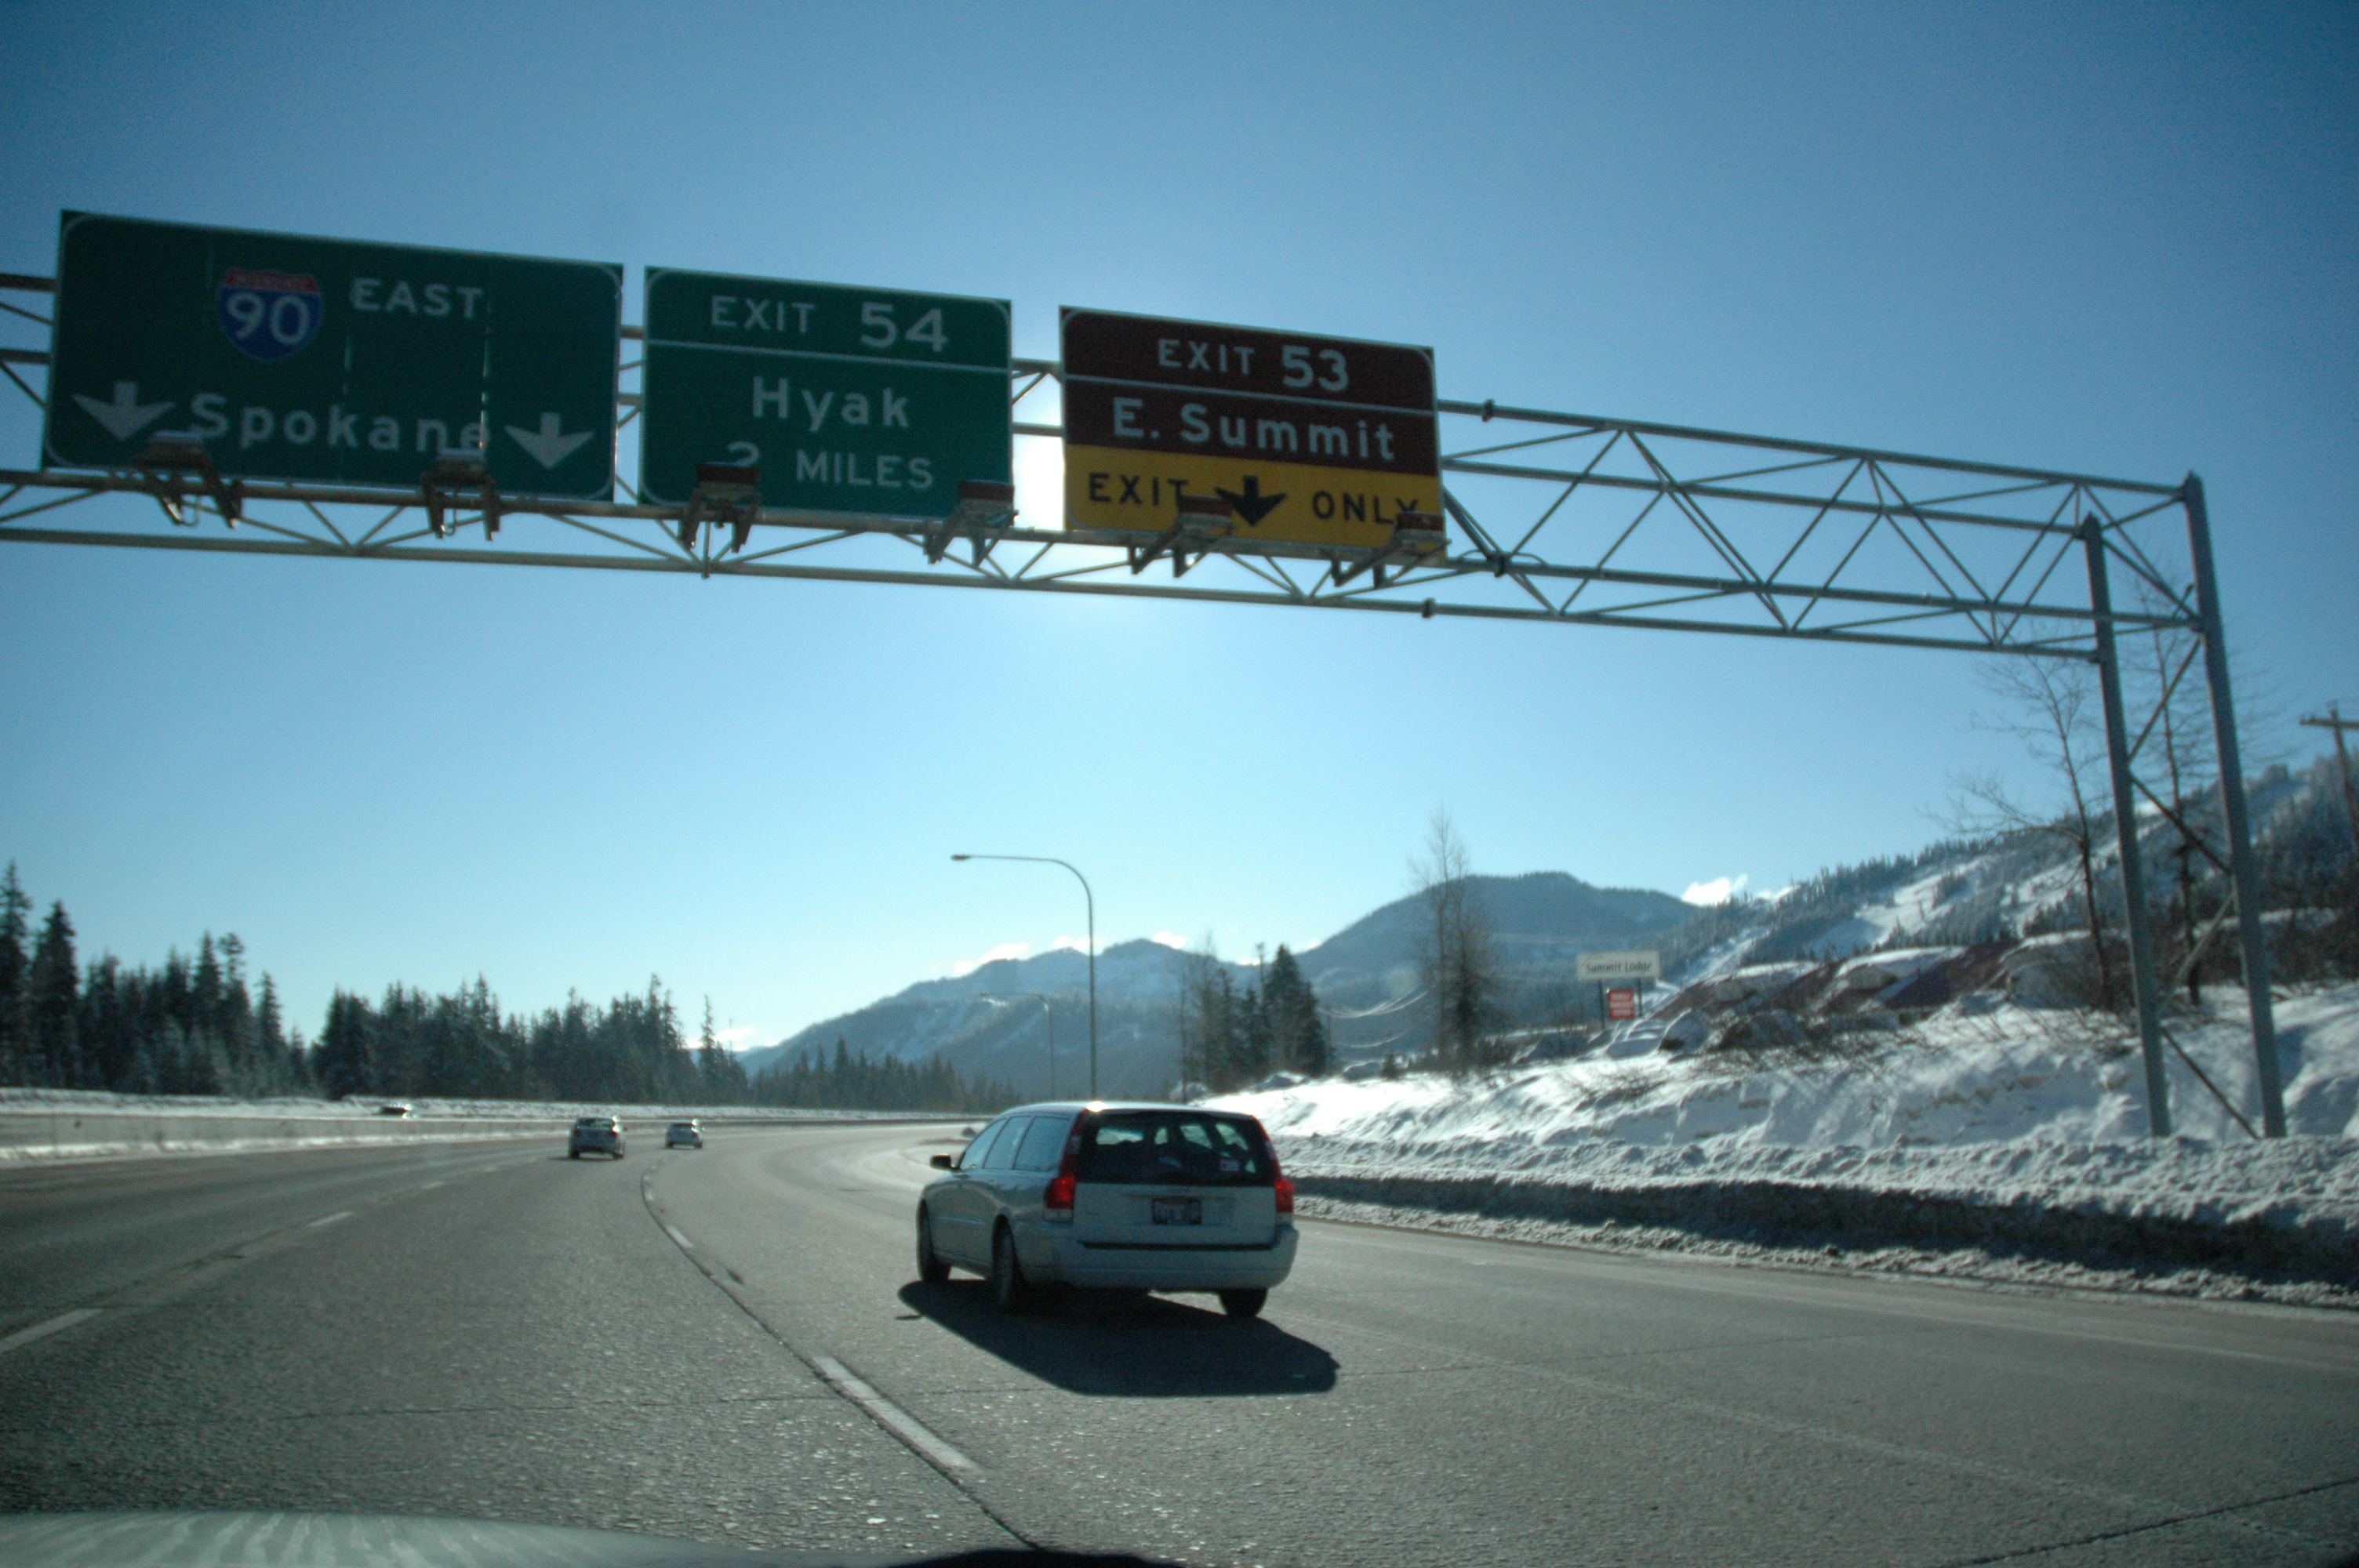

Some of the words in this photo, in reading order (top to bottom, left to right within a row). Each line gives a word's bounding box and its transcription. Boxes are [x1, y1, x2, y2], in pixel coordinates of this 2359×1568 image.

[227, 291, 311, 347] 90
[351, 277, 482, 318] EAST
[711, 295, 815, 335] EXIT
[860, 302, 948, 353] 54
[1158, 337, 1254, 375] EXIT
[1281, 344, 1350, 392] 53
[190, 392, 491, 453] Spokane
[752, 375, 910, 433] Hyak
[1113, 396, 1160, 439] E.
[1180, 402, 1394, 461] Summit
[795, 448, 933, 490] MILES
[1088, 472, 1189, 507] EXIT
[1585, 962, 1622, 975] Summit
